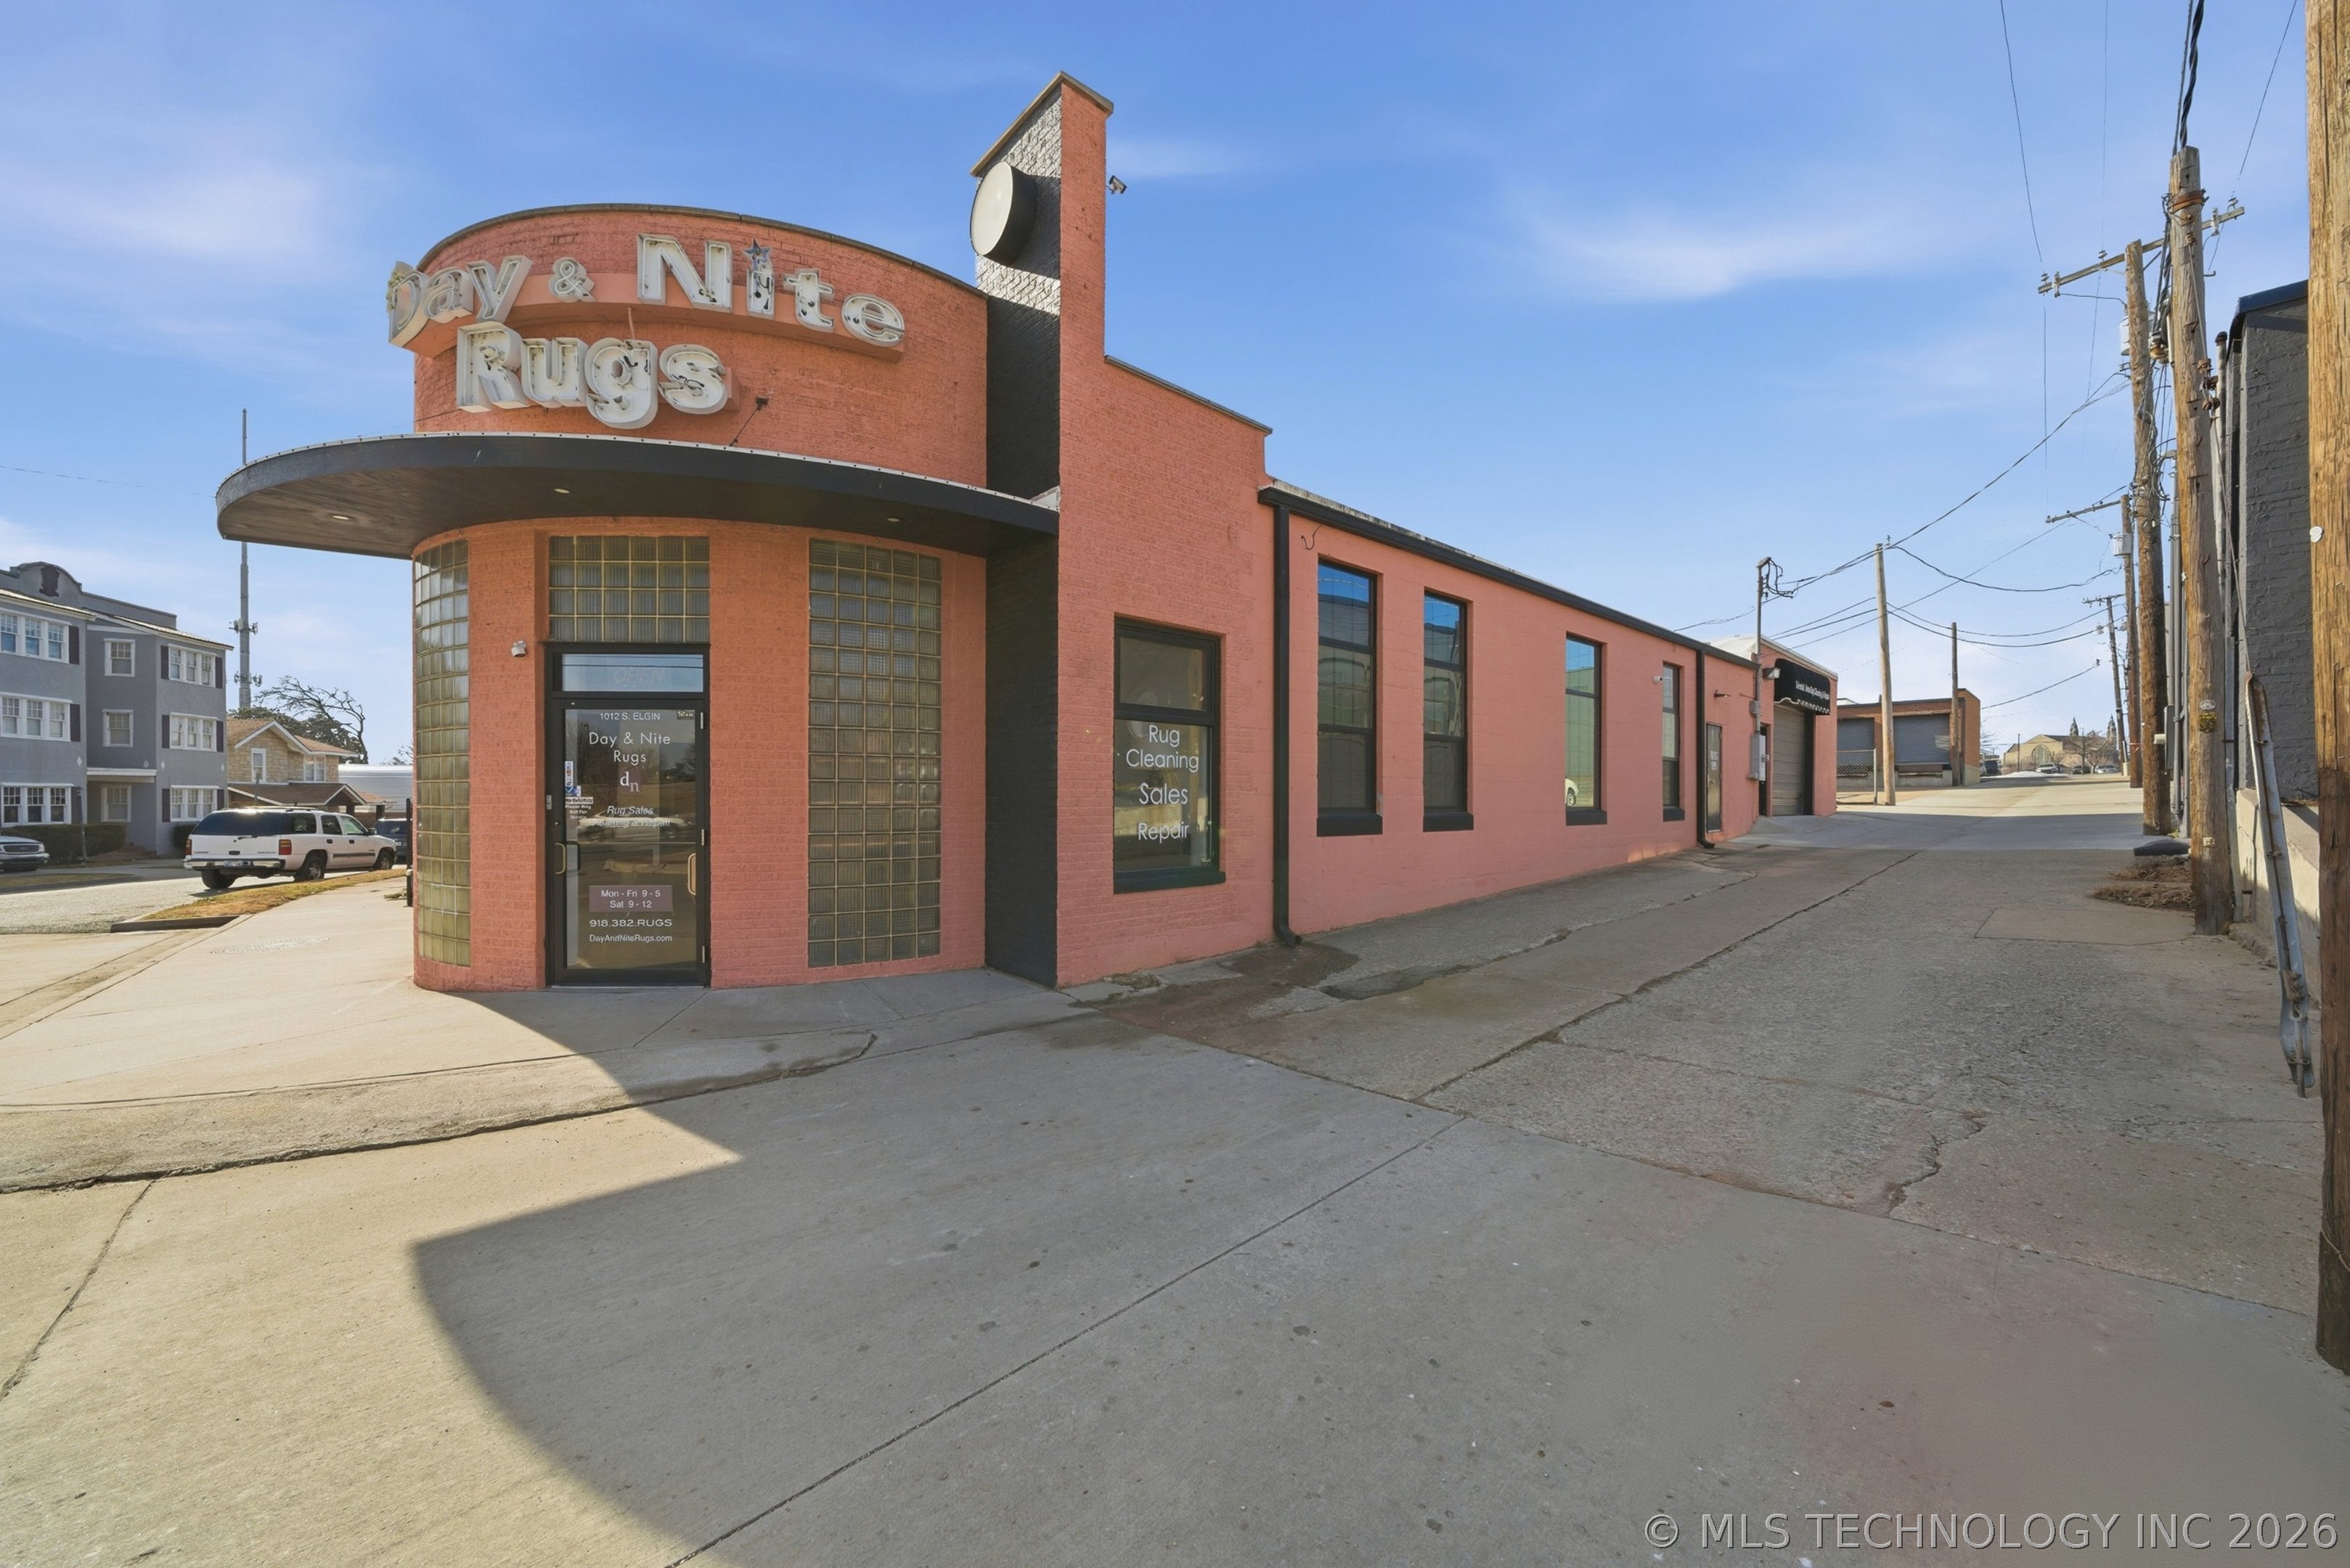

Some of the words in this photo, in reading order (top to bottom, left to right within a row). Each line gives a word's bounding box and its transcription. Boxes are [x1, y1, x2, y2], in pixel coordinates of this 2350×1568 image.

[386, 256, 533, 346] Day
[550, 257, 595, 302] &
[637, 233, 905, 347] Nite
[457, 322, 727, 429] Rugs
[589, 732, 617, 748] Day
[623, 732, 634, 744] &
[640, 732, 671, 745] Nite
[1149, 725, 1180, 748] Rug
[613, 750, 647, 766] Rugs
[1126, 748, 1199, 772] Cleaning
[1139, 783, 1188, 805] Sales
[607, 806, 625, 816] Rug
[628, 806, 654, 814] Sales
[1138, 821, 1189, 844] Repair
[589, 934, 672, 943] DayAndNiteRugs.com
